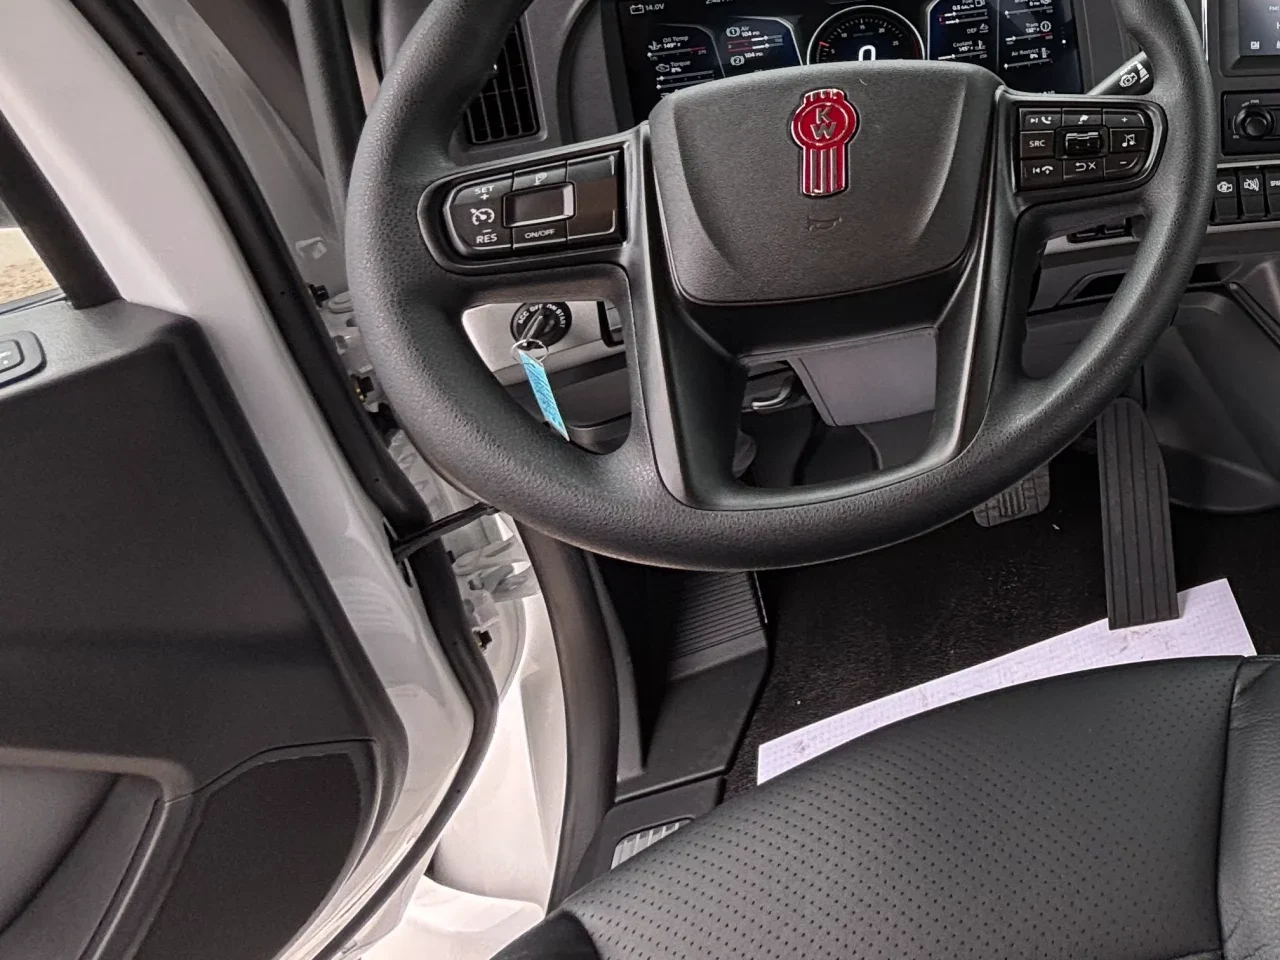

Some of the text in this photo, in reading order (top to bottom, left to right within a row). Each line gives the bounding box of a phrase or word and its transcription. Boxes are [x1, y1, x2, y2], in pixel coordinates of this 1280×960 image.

[474, 185, 495, 194] SET
[476, 233, 498, 244] RES
[524, 228, 555, 239] ON/OFF
[529, 303, 543, 312] OFF
[518, 310, 529, 324] ACC
